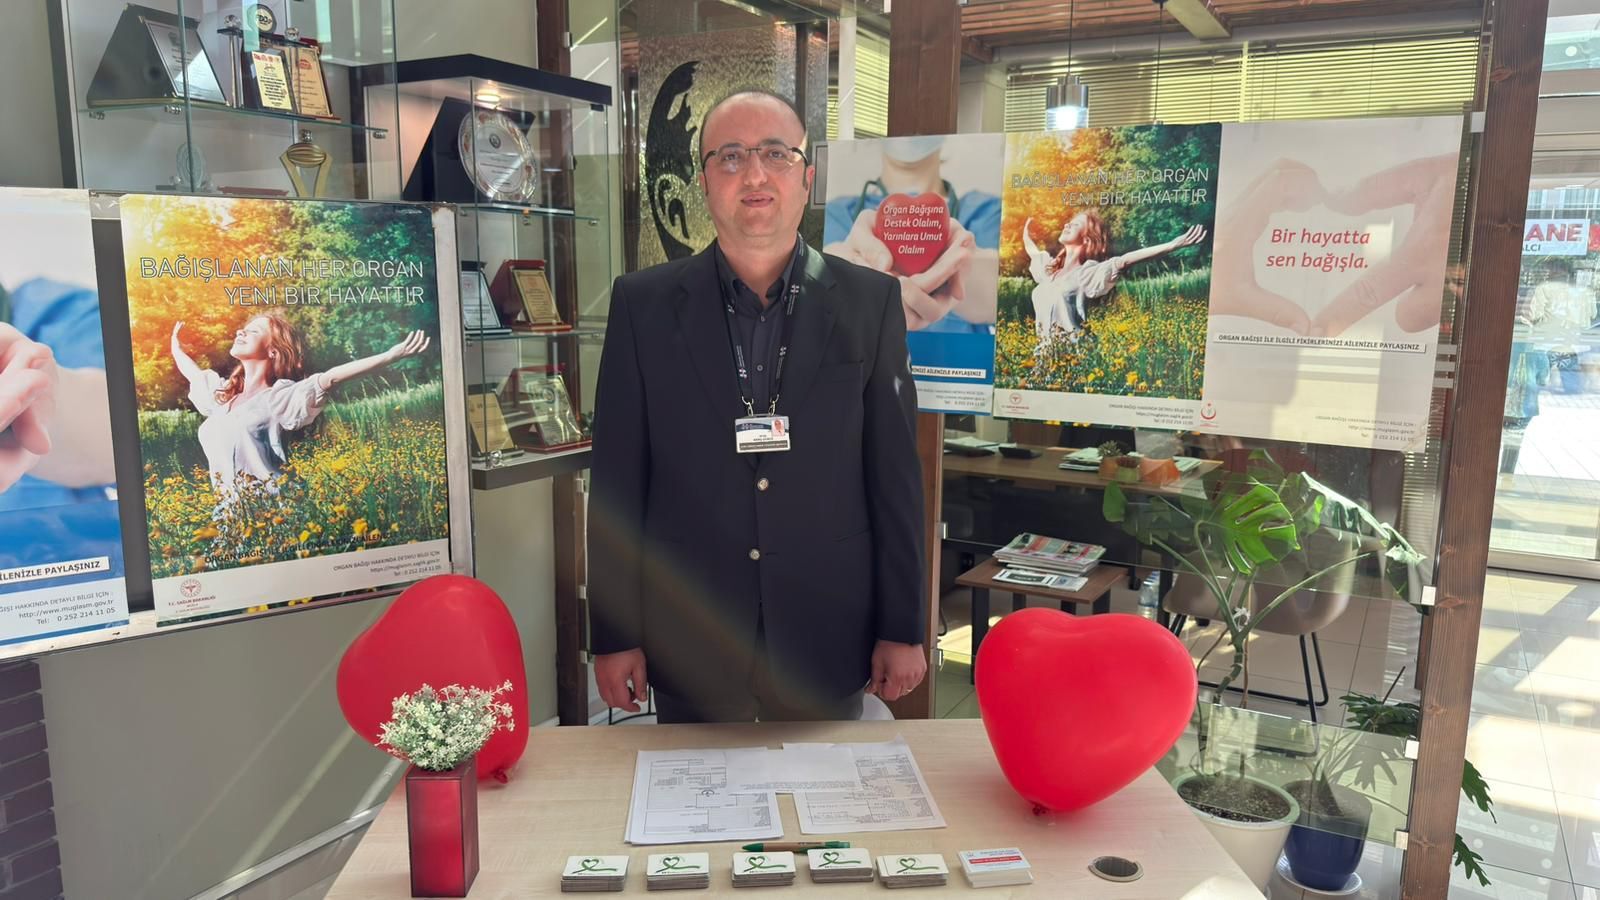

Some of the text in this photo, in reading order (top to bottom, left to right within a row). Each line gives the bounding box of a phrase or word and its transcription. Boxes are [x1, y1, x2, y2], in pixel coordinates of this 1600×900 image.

[1011, 167, 1209, 190] BAĞIŞLANAN HER ORGAN
[1131, 187, 1208, 205] HAYATTIR
[883, 204, 944, 217] Organ Bağışına
[884, 217, 942, 229] Destek Olalım,
[883, 231, 943, 241] Yarınlara Umut
[1271, 228, 1371, 248] Bir hayatta
[1524, 223, 1584, 242] ANE
[898, 245, 925, 255] Olalım
[140, 254, 424, 284] BAĞIŞLANAN HER ORGAN
[1266, 252, 1369, 273] sen bağışla.
[224, 286, 424, 306] YENİ BİR HAYATTIR
[45, 560, 101, 576] PAYLAŞINIZ
[19, 599, 114, 619] http://www.muglasm.gov.tr
[64, 613, 78, 621] 252
[80, 610, 94, 618] 214
